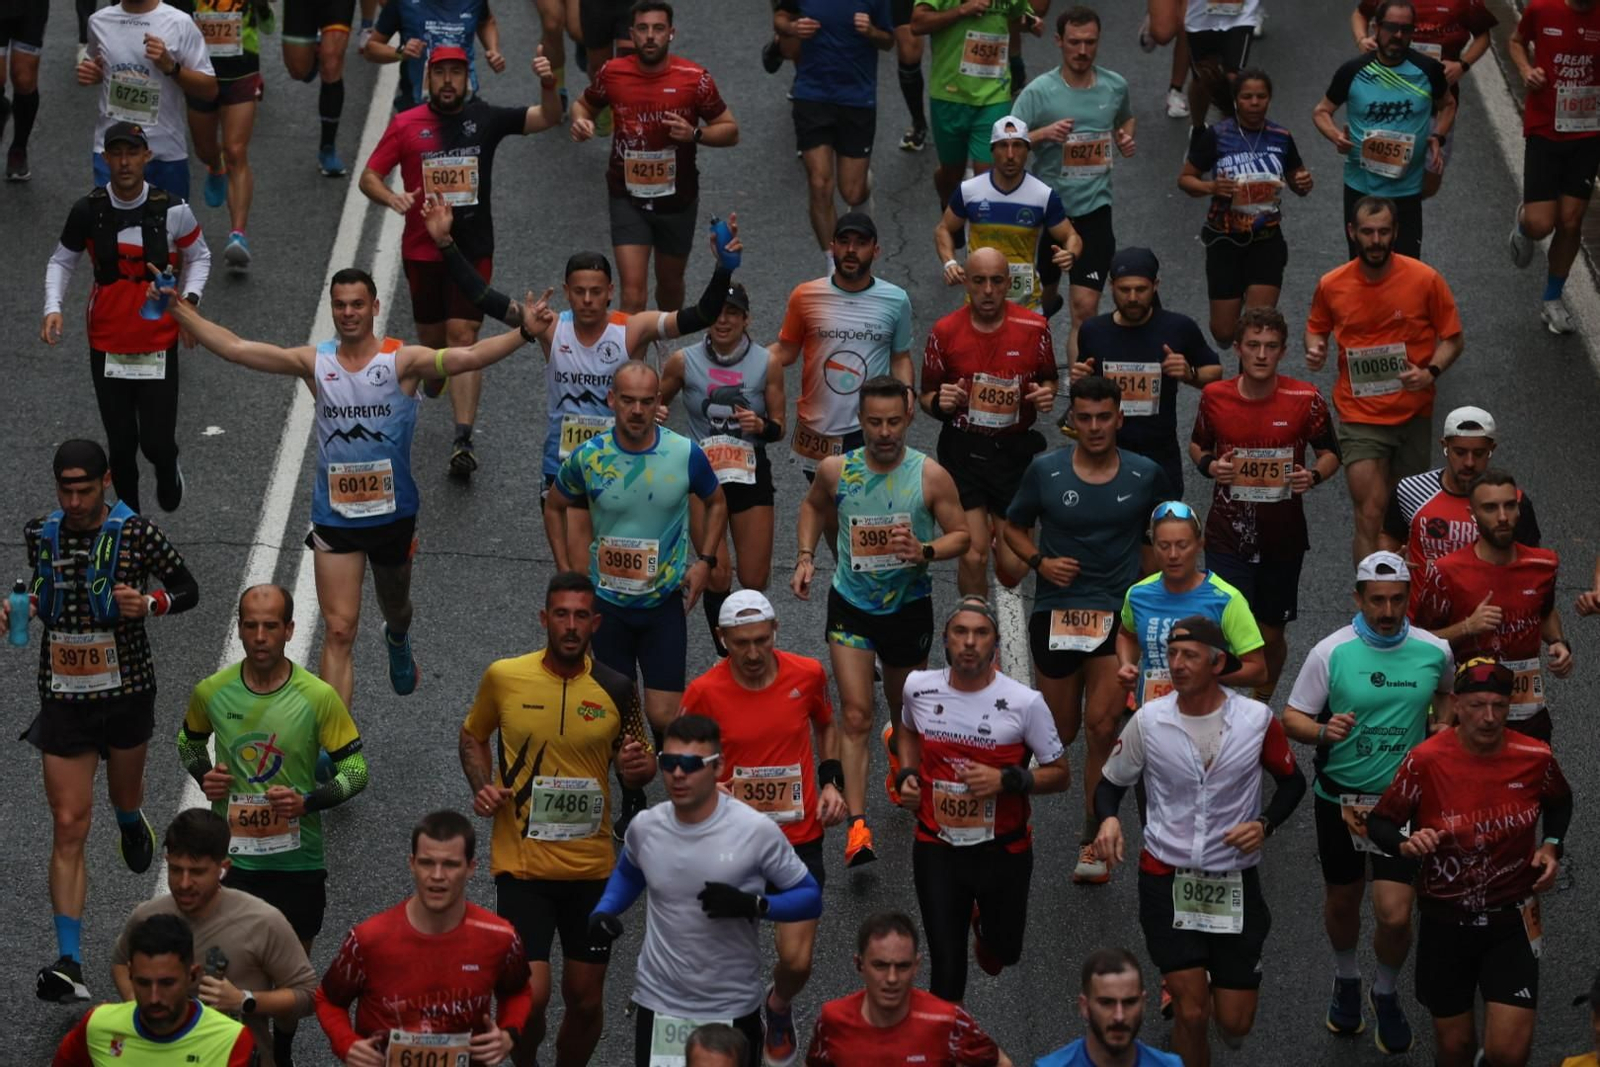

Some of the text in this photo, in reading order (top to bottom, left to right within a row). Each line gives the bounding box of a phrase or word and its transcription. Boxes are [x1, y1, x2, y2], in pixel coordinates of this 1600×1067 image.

[971, 43, 998, 58] 4534
[1553, 53, 1594, 66] BREAK
[1559, 66, 1586, 78] FAST
[116, 85, 148, 103] 6725
[1070, 141, 1102, 159] 6274
[1367, 139, 1402, 159] 4055
[432, 169, 465, 185] 6021
[632, 162, 665, 177] 4215
[1353, 356, 1397, 375] 10086
[570, 373, 614, 387] VEREITA
[978, 387, 1014, 405] 4838
[339, 403, 392, 419] VEREITAS
[798, 432, 829, 454] 5730
[707, 445, 742, 463] 5702
[1240, 461, 1279, 478] 4875
[338, 475, 378, 494] 6012
[859, 528, 894, 546] 398
[604, 550, 643, 570] 3986
[1061, 609, 1098, 628] 4601
[58, 647, 100, 665] 3978
[1386, 680, 1417, 689] training
[743, 782, 787, 801] 3597
[543, 793, 589, 813] 7486
[940, 798, 978, 818] 4582
[1183, 881, 1226, 904] 9822
[400, 1048, 450, 1067] 6101
